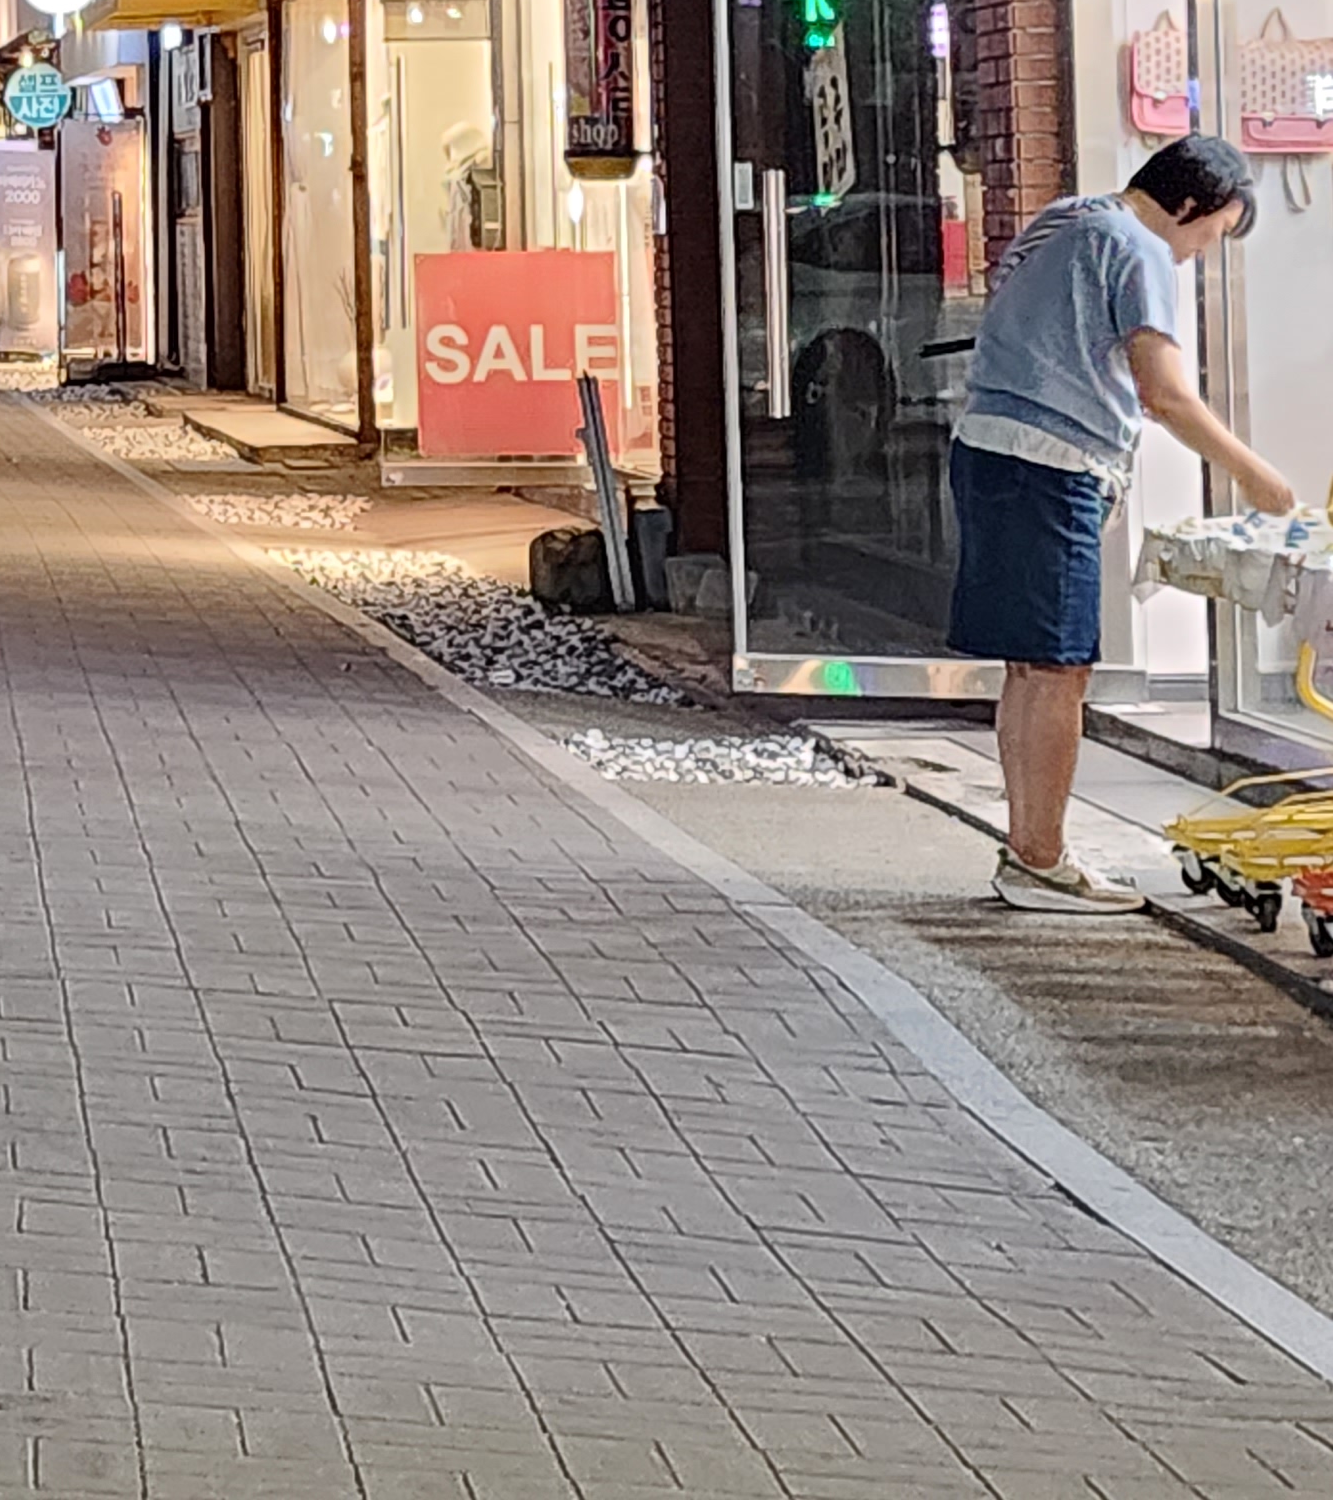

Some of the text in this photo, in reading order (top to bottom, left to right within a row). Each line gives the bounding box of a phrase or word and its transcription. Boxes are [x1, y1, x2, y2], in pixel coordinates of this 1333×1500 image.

[18, 72, 59, 93] 셀프
[21, 97, 60, 121] 사진
[572, 117, 619, 150] shop
[424, 323, 619, 385] SALE
